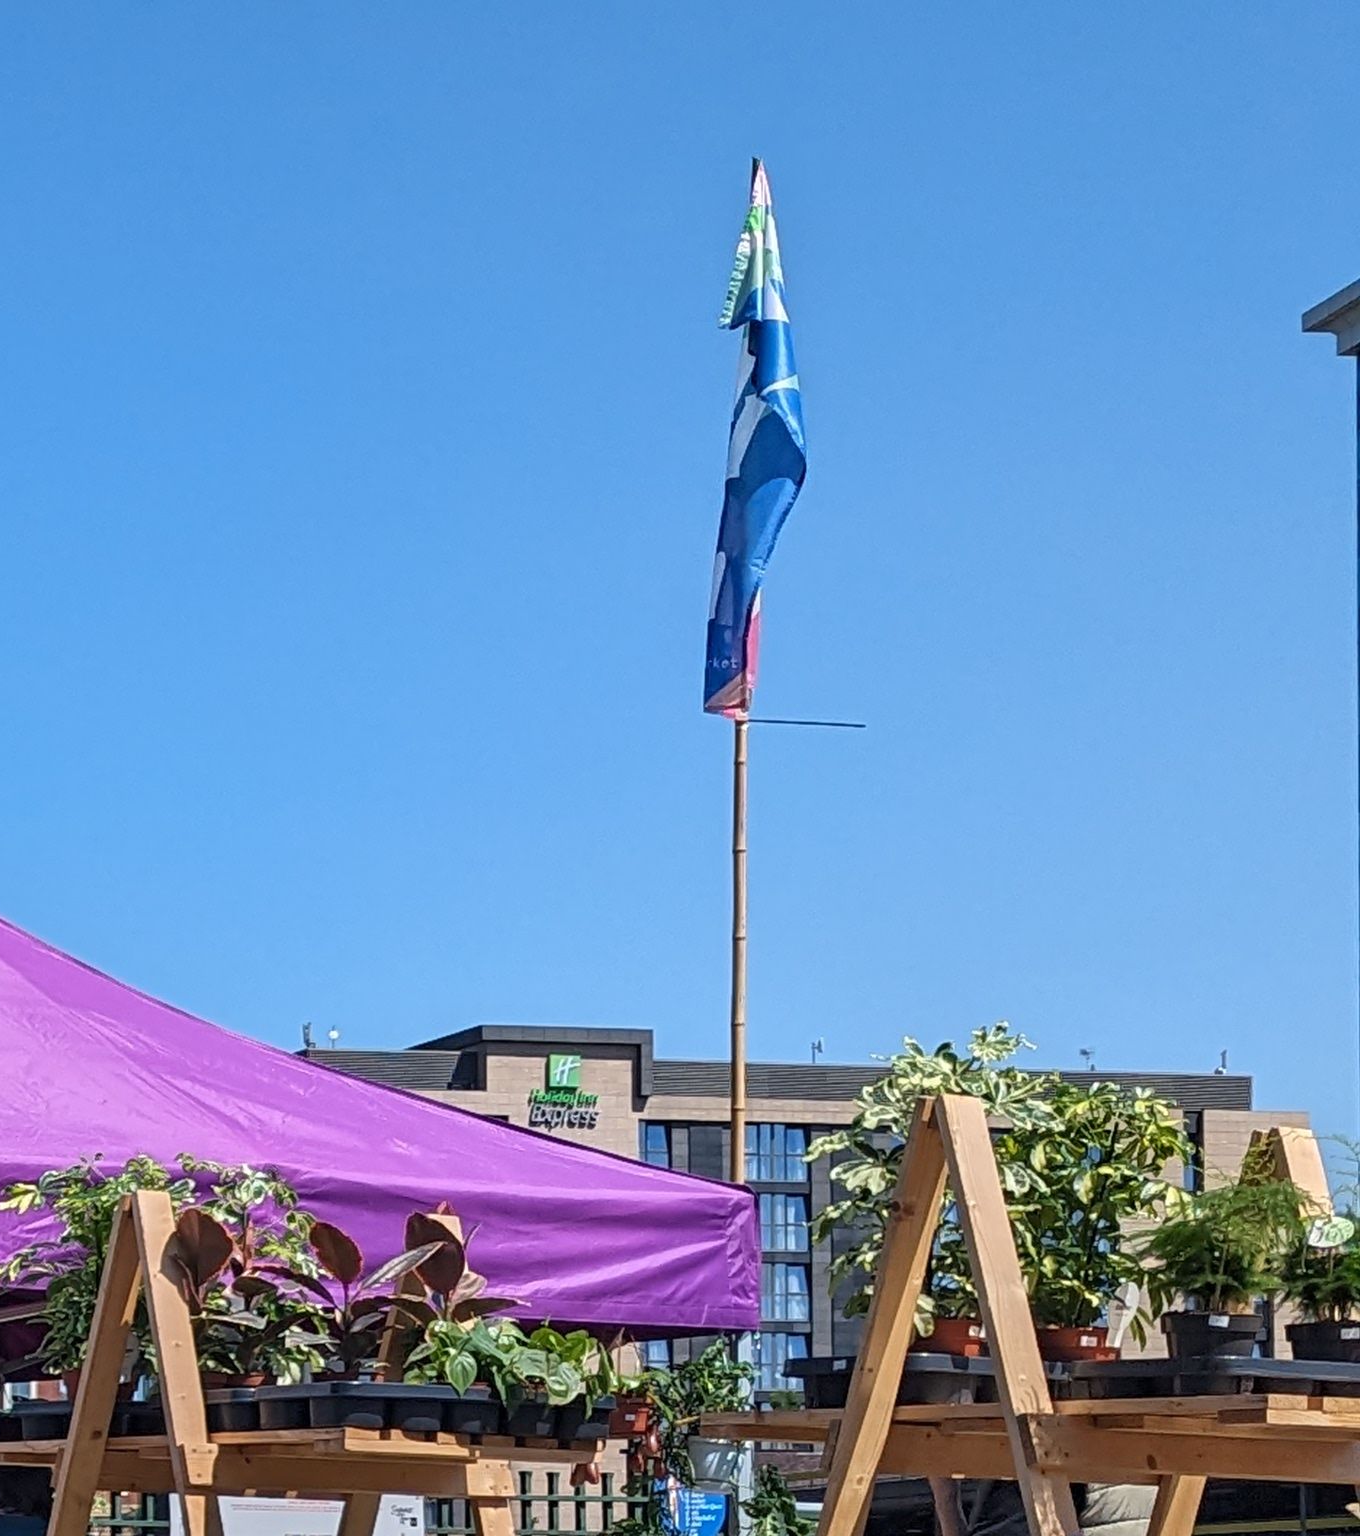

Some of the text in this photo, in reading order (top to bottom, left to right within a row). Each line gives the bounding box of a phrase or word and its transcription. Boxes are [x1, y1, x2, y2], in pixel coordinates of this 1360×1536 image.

[531, 1088, 599, 1106] Holiday Inn
[531, 1104, 600, 1128] Express
